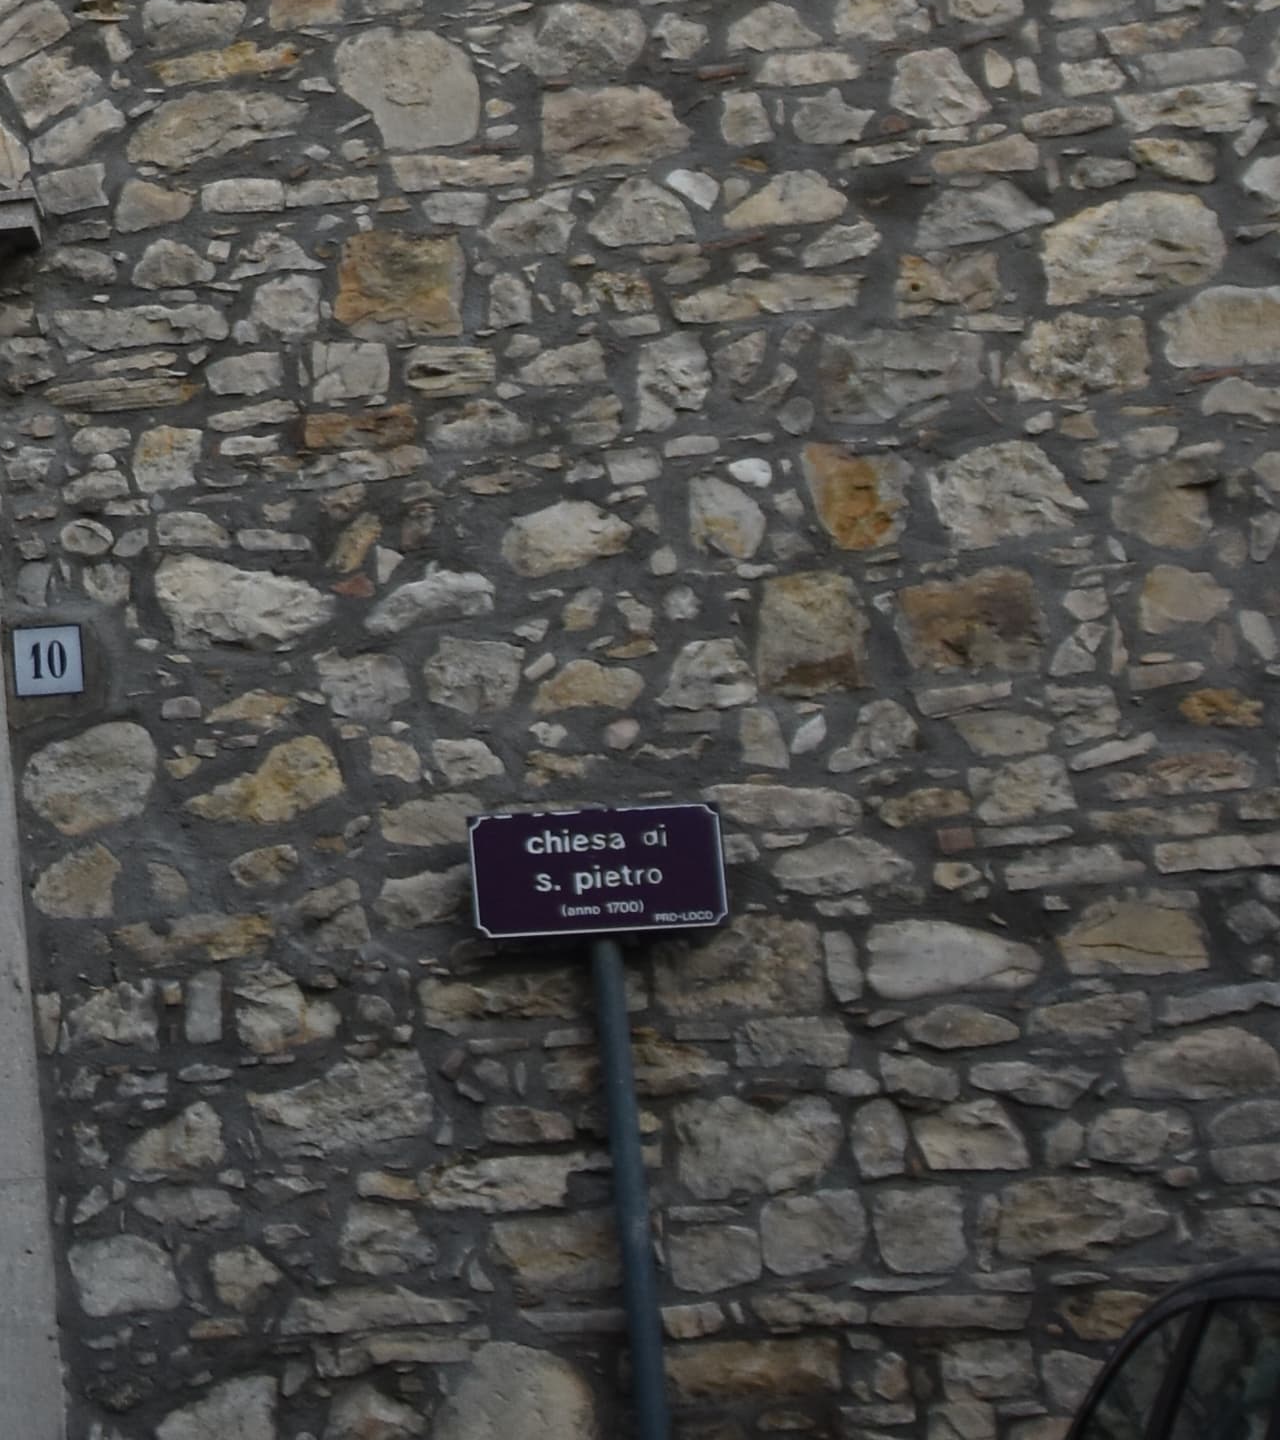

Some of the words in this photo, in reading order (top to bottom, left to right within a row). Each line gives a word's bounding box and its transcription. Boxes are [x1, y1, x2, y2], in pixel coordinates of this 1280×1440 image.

[31, 640, 67, 679] 10
[526, 829, 626, 855] chiesa
[643, 824, 668, 847] di
[535, 871, 561, 892] s.
[574, 864, 663, 895] pietro
[561, 903, 601, 918] (anno
[606, 899, 645, 914] 1700)
[655, 909, 714, 922] PRO-LOCO
